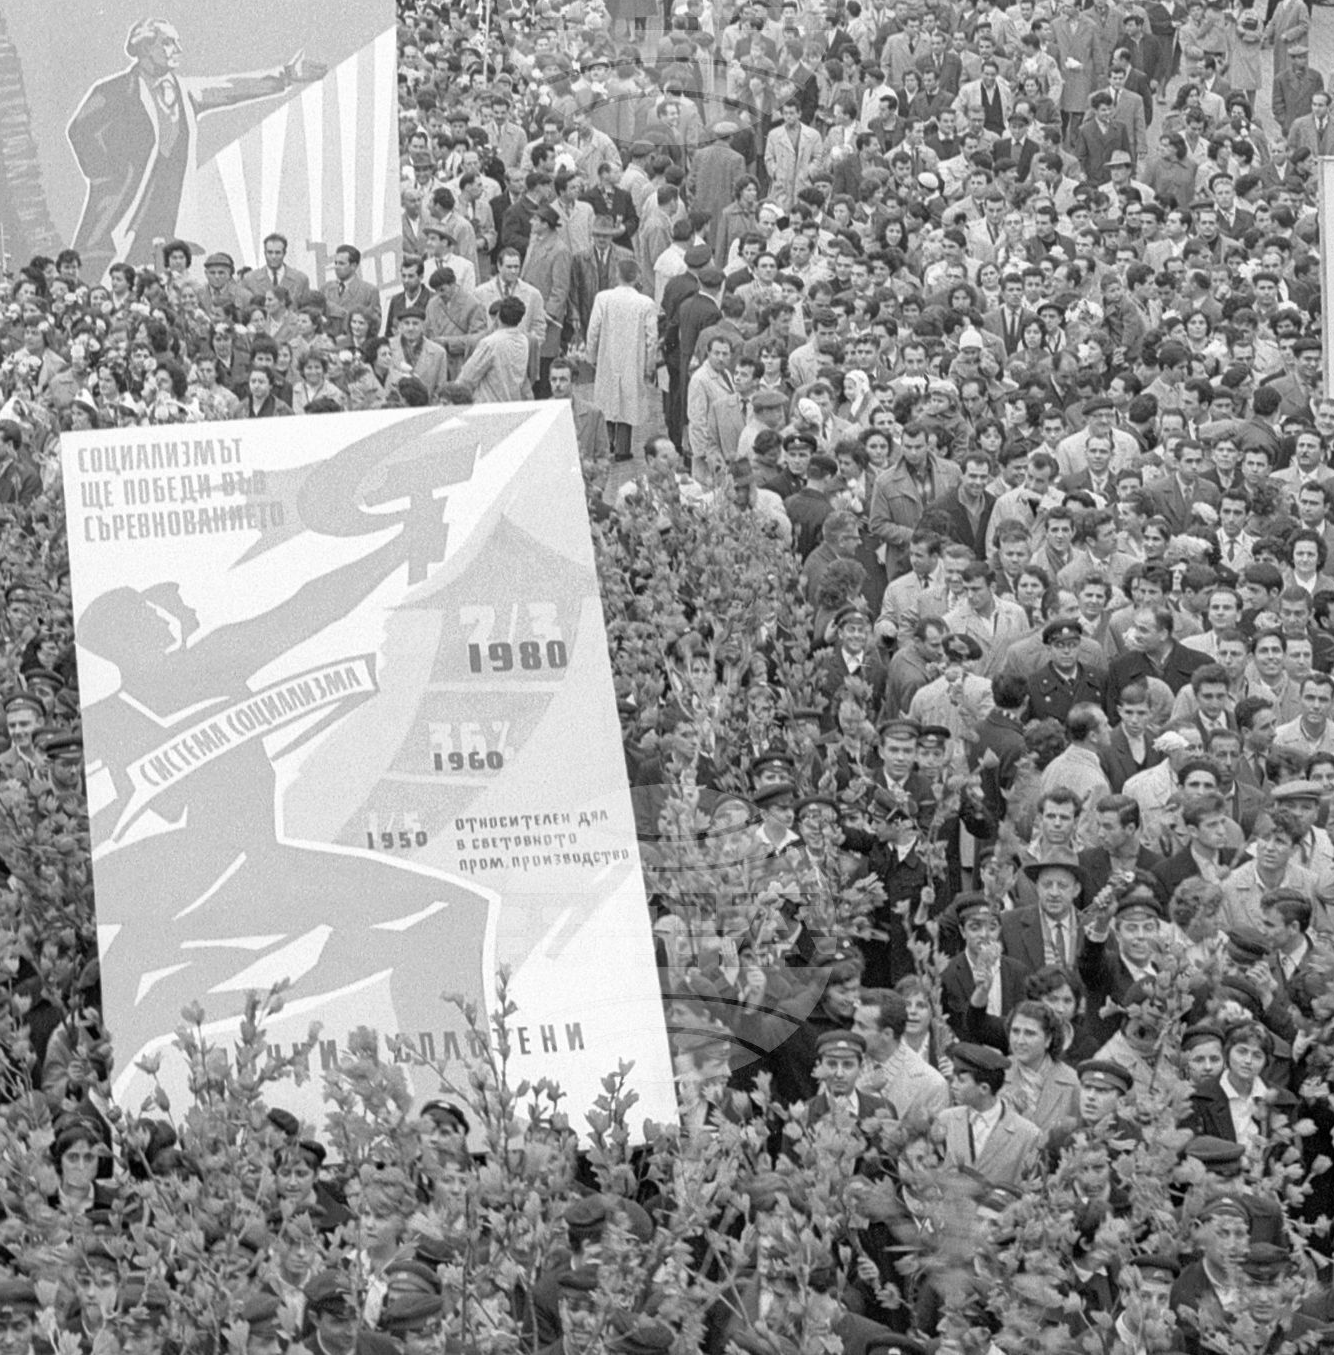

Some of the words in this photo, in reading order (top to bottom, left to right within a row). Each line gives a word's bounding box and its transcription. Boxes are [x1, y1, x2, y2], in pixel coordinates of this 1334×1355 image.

[77, 438, 242, 475] СОЦИАЛИЗМЪТ
[80, 480, 114, 511] ЩЕ
[123, 473, 212, 505] ПОБЕДИ
[221, 469, 267, 497] ВЪВ
[83, 500, 285, 542] СЪРЕВНОВАНИЕТО
[468, 640, 568, 673] 1980
[139, 721, 231, 787] СИСТЕМА
[226, 665, 364, 737] СОЦИАЛИЗМА
[433, 751, 504, 771] 1960
[455, 812, 571, 833] ОТНОСИТЕЛЕН
[578, 809, 609, 828] ДЯЛ
[367, 831, 428, 850] 1950
[456, 839, 466, 851] В
[471, 833, 577, 851] СВЕТОВНОТО
[511, 849, 630, 872] ПРОИЗВОДСТВО
